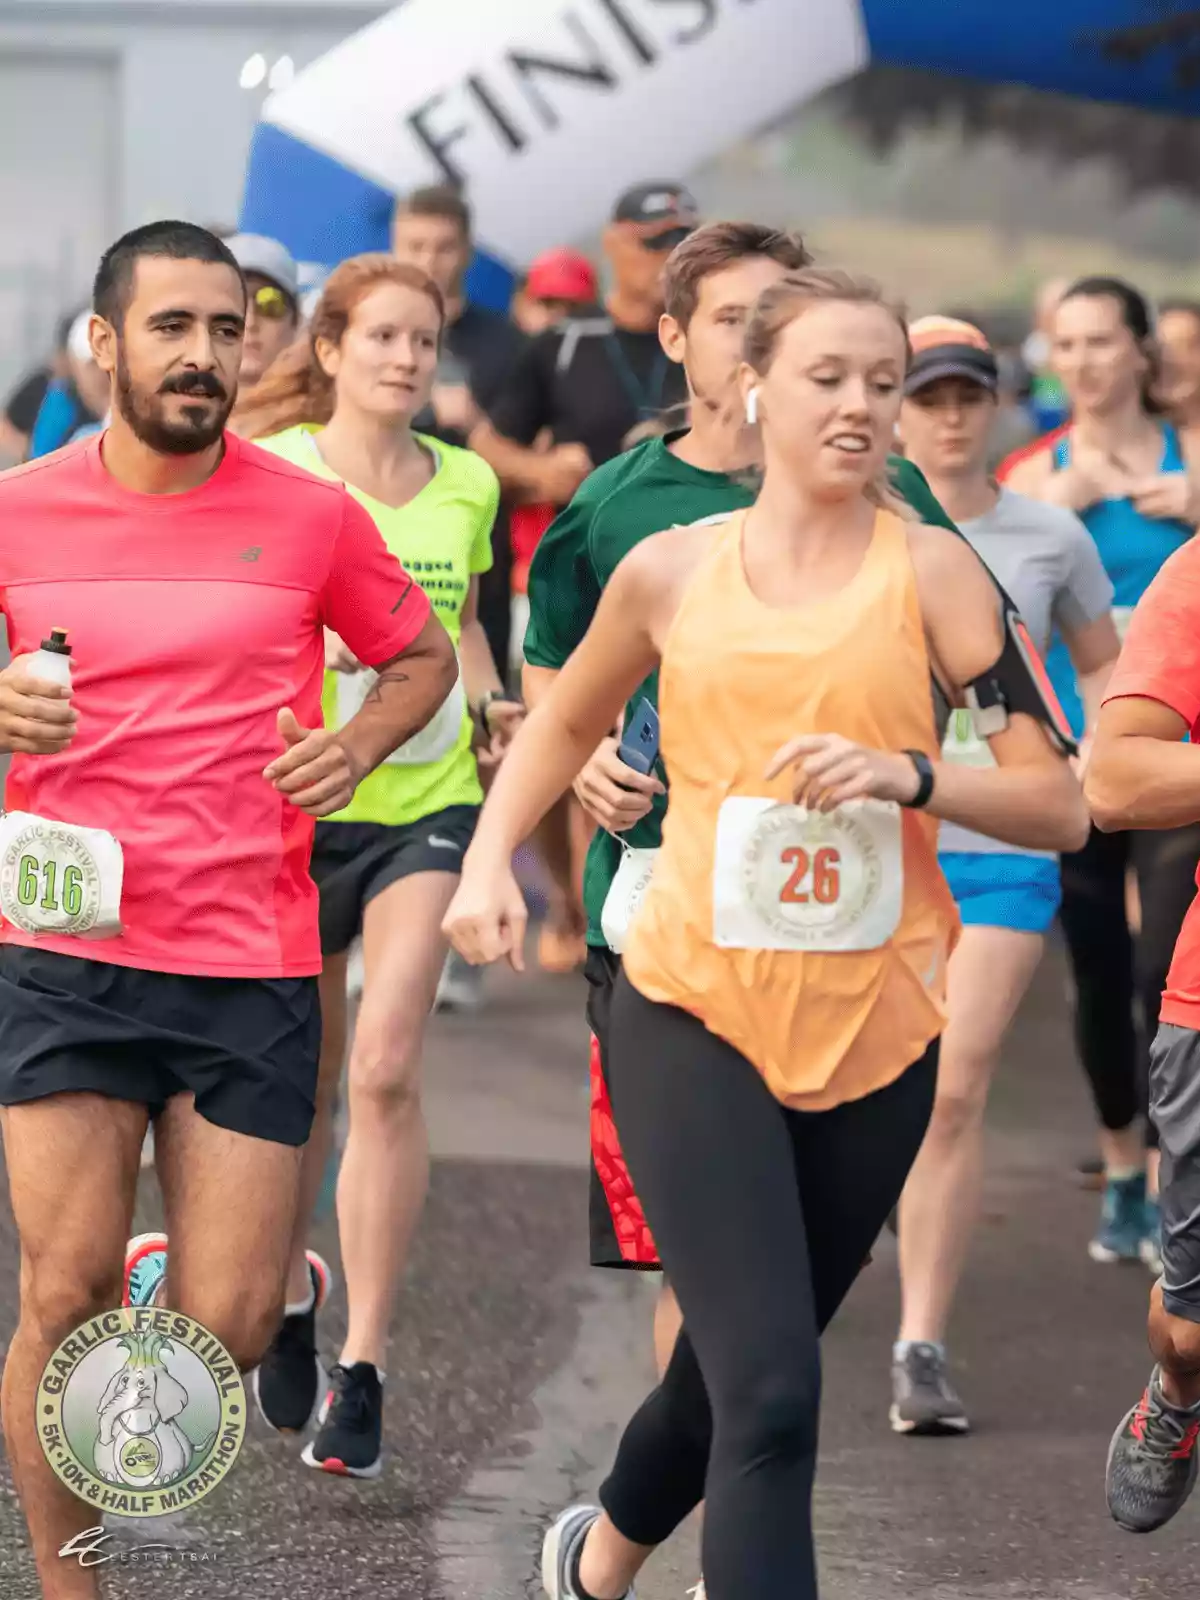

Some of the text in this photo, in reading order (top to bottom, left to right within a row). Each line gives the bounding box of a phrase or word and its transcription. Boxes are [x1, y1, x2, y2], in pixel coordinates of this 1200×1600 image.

[404, 0, 758, 190] FINIS
[6, 825, 98, 887] GARLIC FESTIVAL
[17, 854, 83, 916] 616
[778, 845, 842, 904] 26
